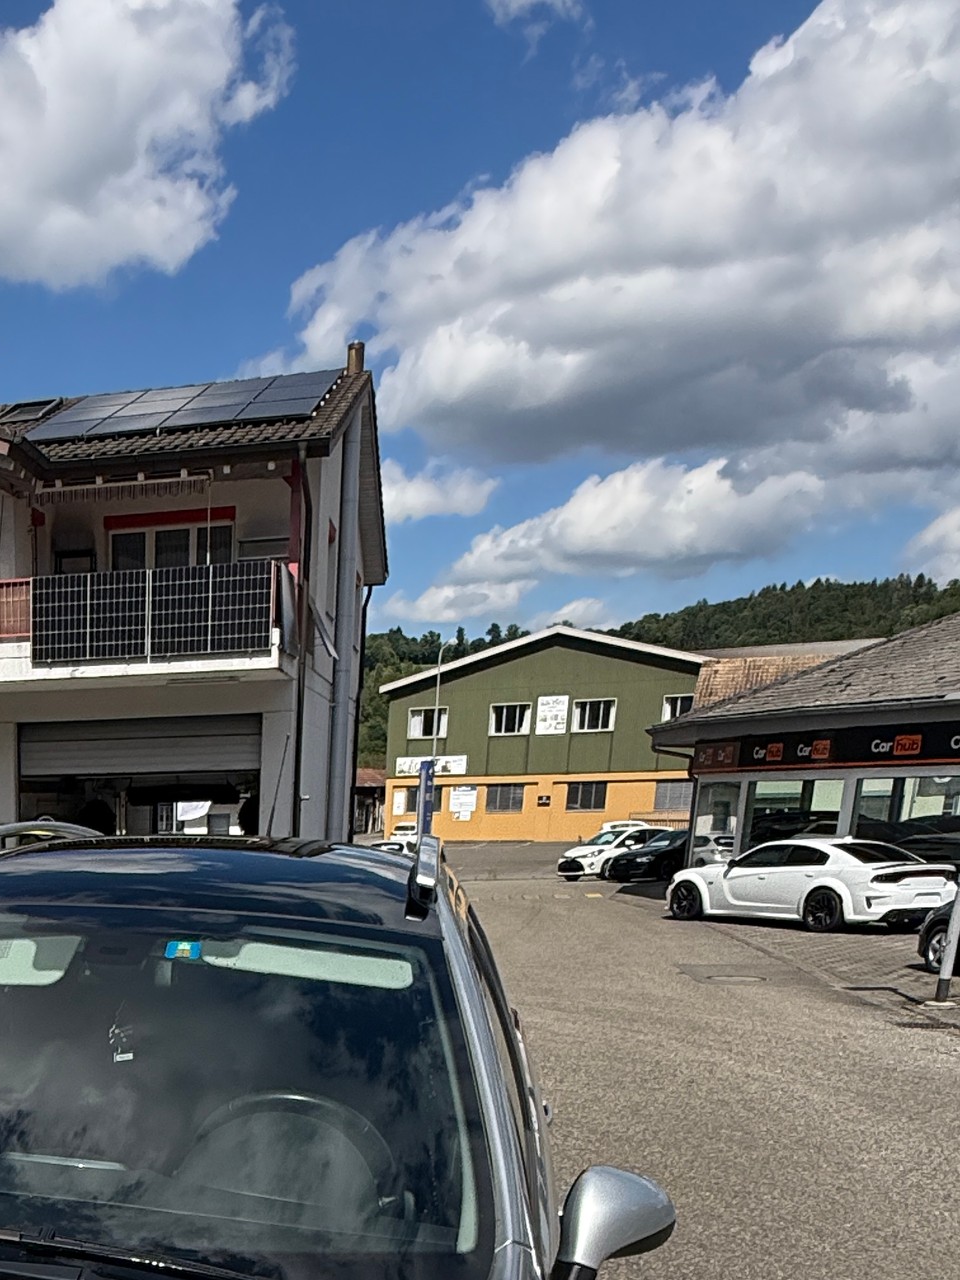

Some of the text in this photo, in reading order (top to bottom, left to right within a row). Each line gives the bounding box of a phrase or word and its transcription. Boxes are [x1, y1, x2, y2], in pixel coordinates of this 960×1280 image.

[797, 743, 811, 757] Car
[871, 738, 920, 753] Car hub
